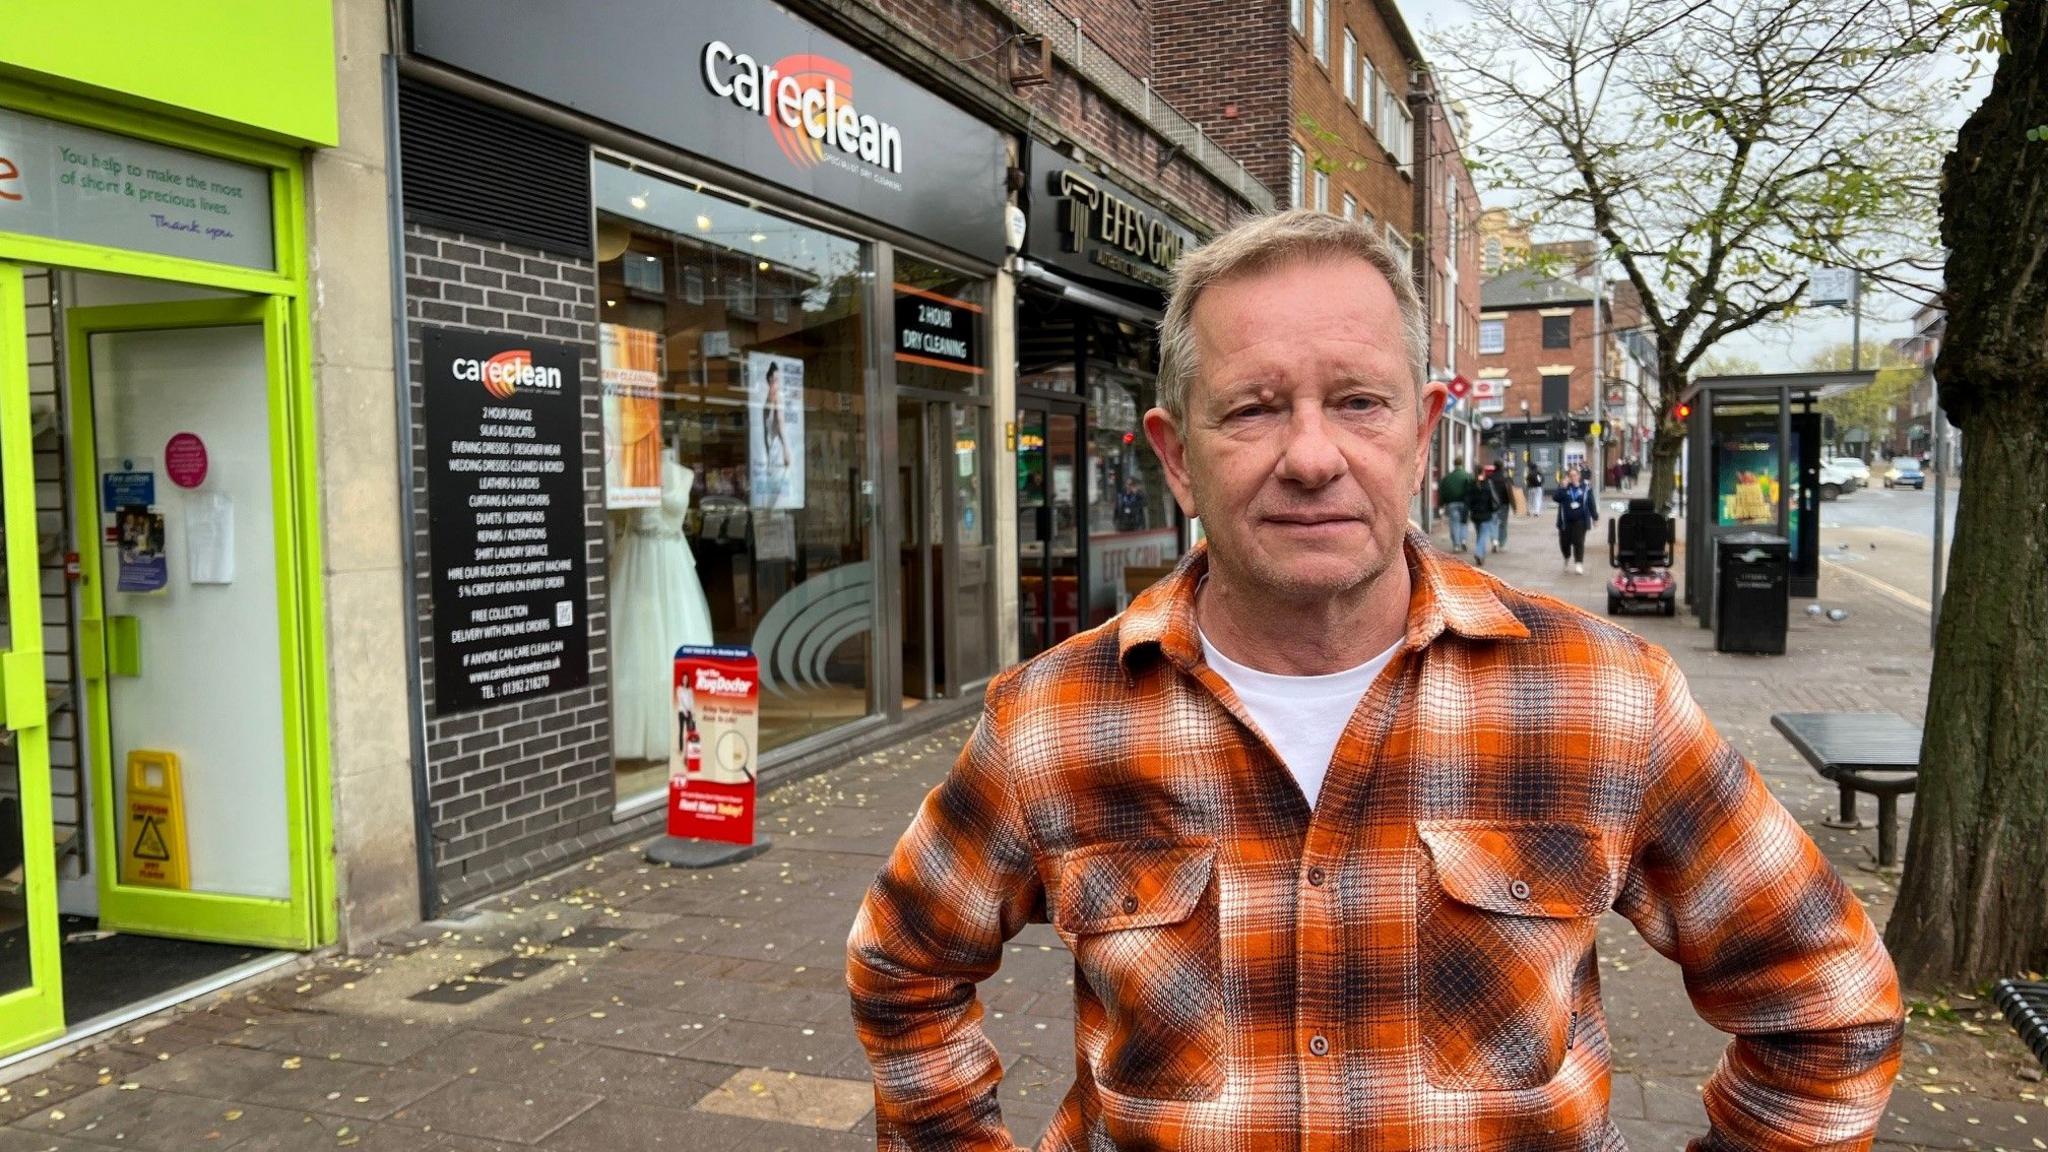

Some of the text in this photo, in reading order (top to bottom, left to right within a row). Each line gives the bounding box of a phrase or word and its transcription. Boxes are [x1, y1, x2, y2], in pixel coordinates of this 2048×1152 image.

[705, 40, 903, 174] careclean
[60, 146, 242, 198] You help to make the most
[60, 171, 231, 215] of short & precious lives.
[150, 214, 200, 233] Thank
[1101, 191, 1184, 267] EFES GRI
[918, 304, 952, 329] 2 HOUR
[902, 328, 967, 359] DRY CLEANING
[452, 357, 562, 389] careclean
[482, 406, 533, 421] 2 HOUR SERVICE
[452, 441, 481, 453] EVENING
[482, 441, 510, 454] DRESSES
[514, 442, 543, 455] DESIGNER
[543, 443, 561, 456] WEAR
[448, 459, 482, 472] WEDDING
[482, 459, 510, 472] DRESSES
[510, 459, 539, 472] CLEANED
[479, 477, 510, 490] LEATHERS
[469, 494, 501, 507] CURTAINS
[507, 494, 527, 507] CHAIR
[526, 494, 551, 507] COVERS
[476, 512, 502, 525] DUVETS
[506, 511, 546, 524] BEDSPREADS
[477, 529, 503, 543] REPAIRS
[507, 527, 548, 541] ALTERATIONS
[475, 544, 549, 561] SHIRT LAUNDRY SERVICE
[448, 558, 572, 580] HIRE OUR RUG DOCTOR CARPET MACHINE
[471, 582, 495, 596] CREDIT
[495, 580, 515, 594] GIVEN
[515, 579, 526, 592] ON
[526, 578, 544, 591] EVERY
[471, 604, 529, 622] FREE COLLECTION
[451, 627, 483, 643] DELIVERY
[484, 625, 501, 639] WITH
[501, 621, 526, 637] ONLINE
[463, 640, 564, 667] IF ANYONE CAN CARE CLEAN CAN
[481, 684, 495, 699] TEL
